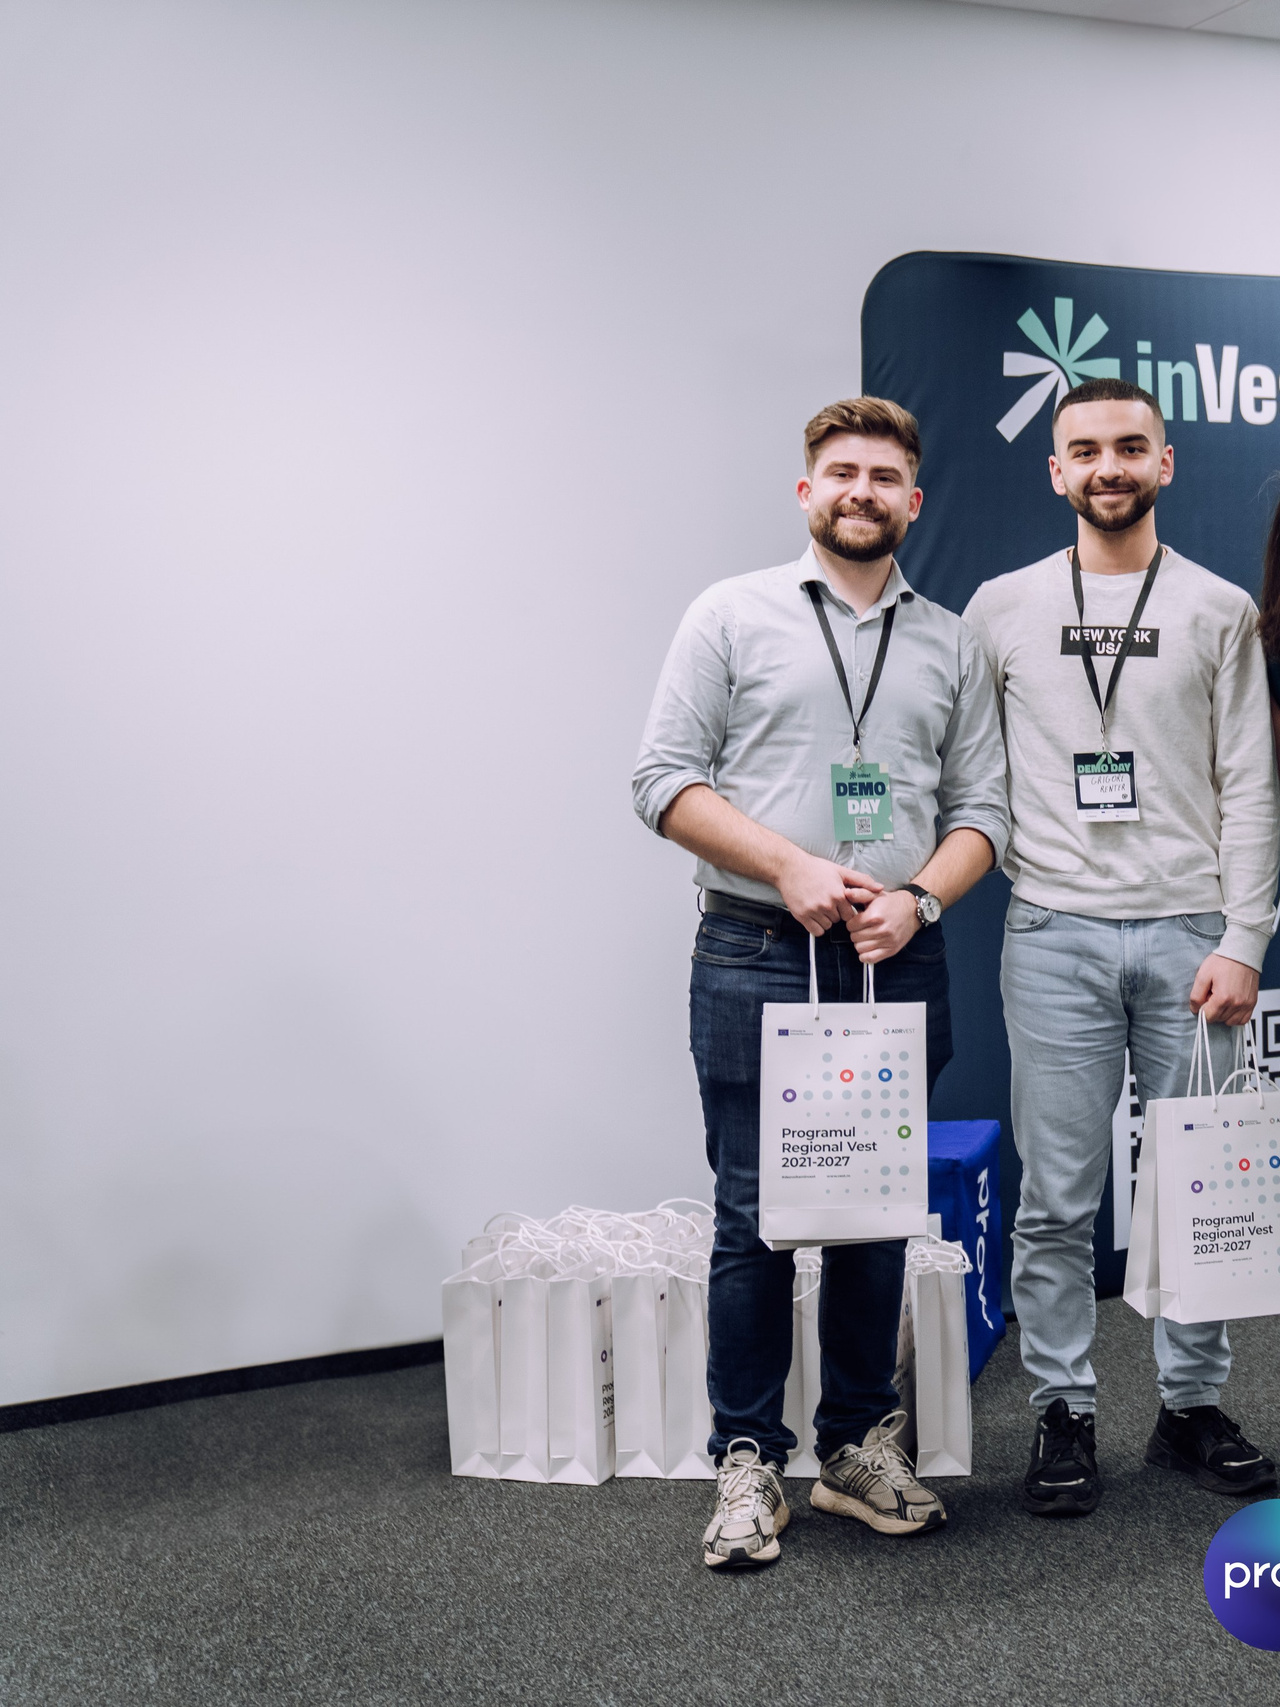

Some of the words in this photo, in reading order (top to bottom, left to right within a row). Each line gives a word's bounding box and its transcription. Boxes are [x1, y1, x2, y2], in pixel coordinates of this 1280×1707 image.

[1069, 628, 1105, 641] NEW
[1108, 629, 1151, 643] YORK
[1077, 763, 1109, 774] DEMO
[1110, 762, 1131, 773] DAY
[836, 781, 886, 797] DEMO
[847, 798, 880, 815] DAY
[782, 1126, 856, 1141] Programul
[782, 1141, 843, 1156] Regional
[847, 1141, 878, 1152] Vest
[781, 1156, 851, 1168] 2021-2027
[1192, 1211, 1255, 1228] Programul
[1193, 1226, 1245, 1242] Regional
[1248, 1224, 1274, 1236] Vest
[1193, 1240, 1251, 1255] 2021-2027
